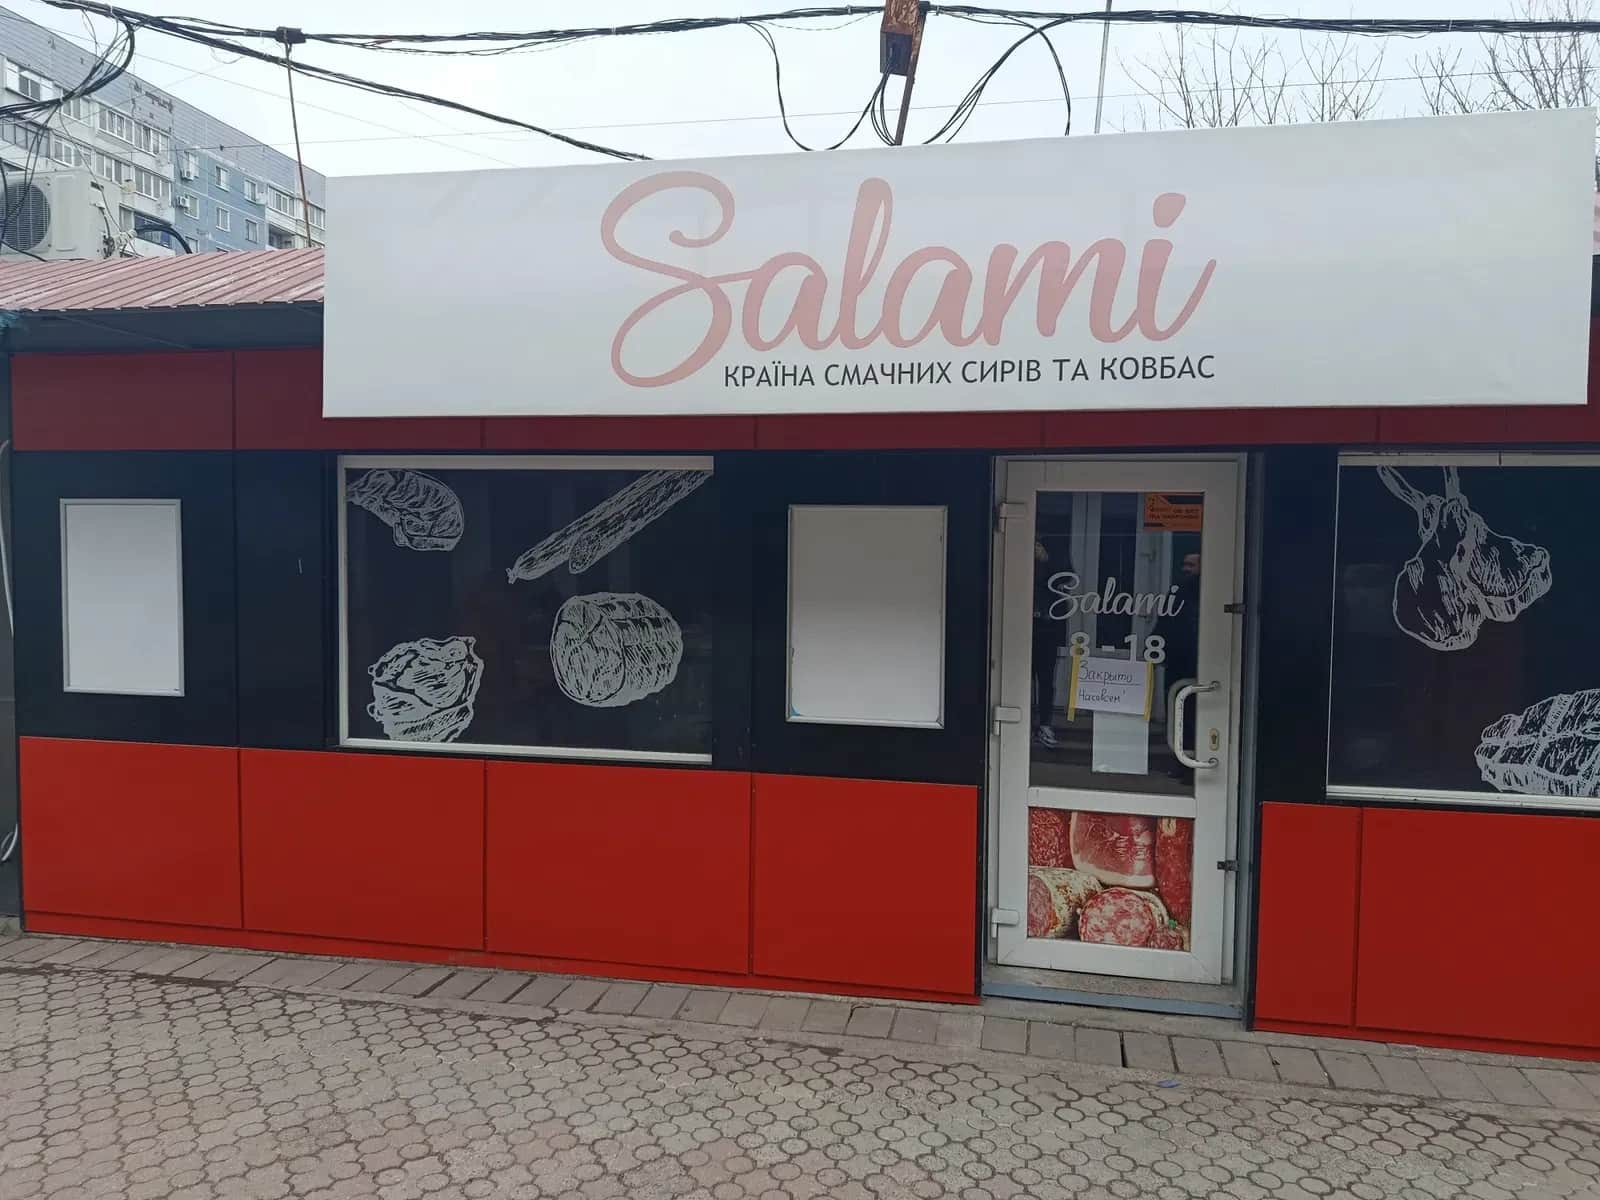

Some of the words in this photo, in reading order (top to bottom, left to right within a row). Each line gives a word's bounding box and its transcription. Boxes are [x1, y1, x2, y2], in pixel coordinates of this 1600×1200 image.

[600, 170, 1217, 388] Salami
[724, 360, 815, 387] КРАЇНА
[824, 361, 952, 386] СМАЧНИХ
[961, 359, 1042, 383] СИРІВ
[1052, 358, 1089, 381] ТА
[1100, 355, 1215, 381] КОВБАС
[1047, 571, 1185, 621] Salami
[1069, 631, 1090, 658] 8
[1124, 633, 1167, 664] 18
